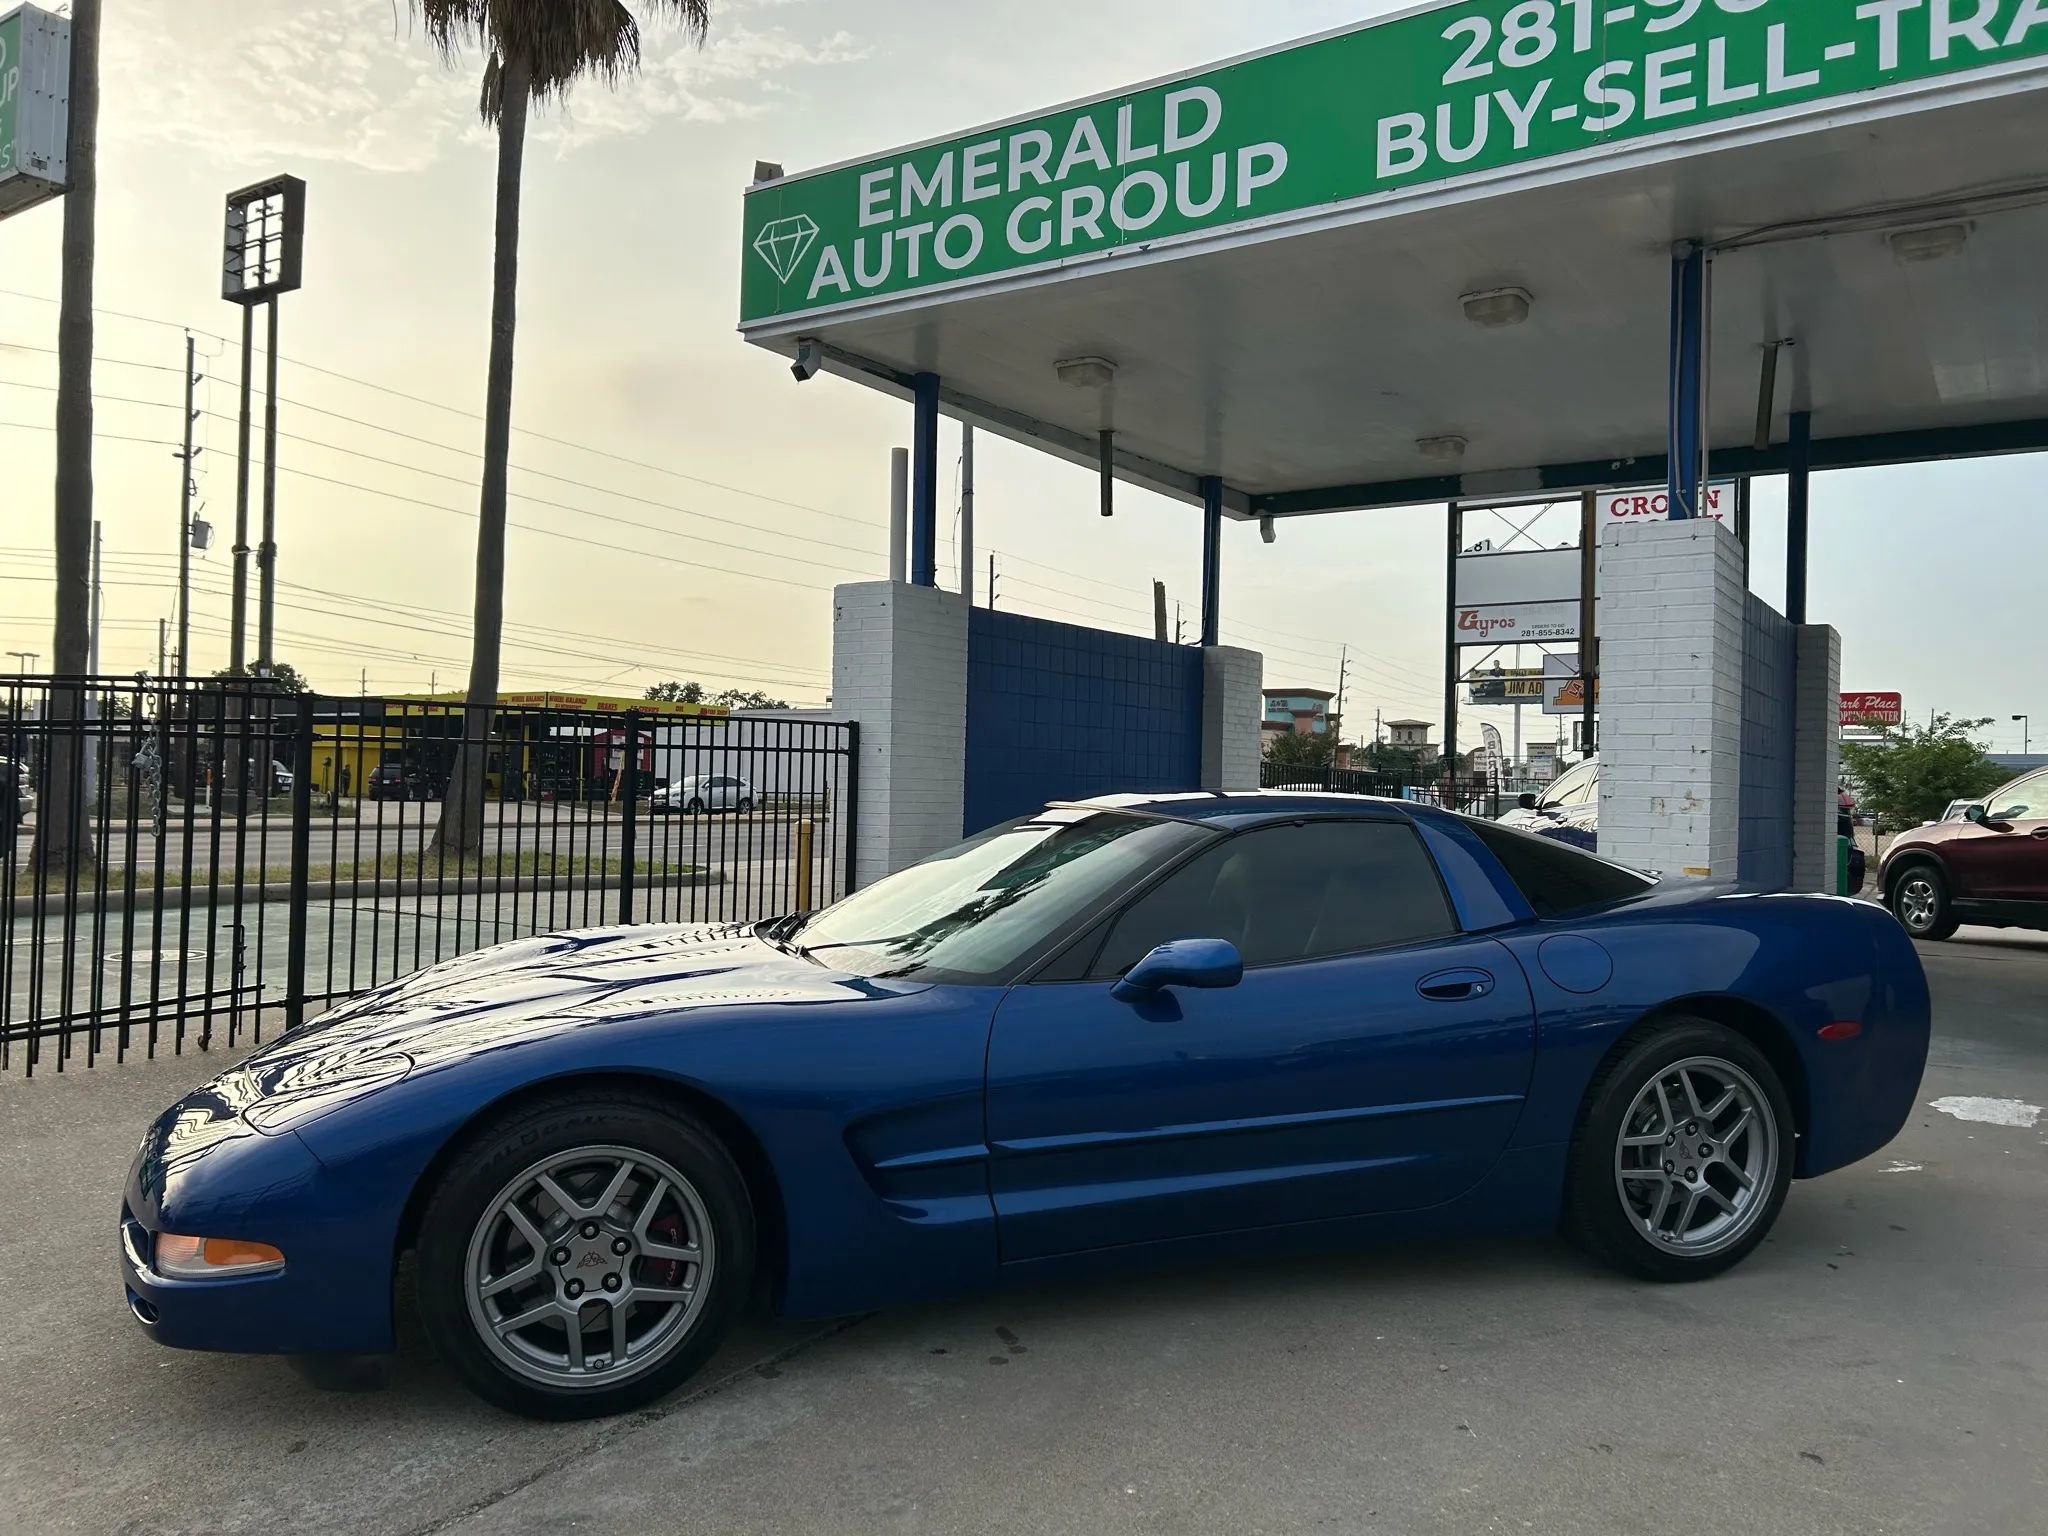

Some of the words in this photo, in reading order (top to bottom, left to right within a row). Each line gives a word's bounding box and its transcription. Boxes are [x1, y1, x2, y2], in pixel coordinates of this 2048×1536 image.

[858, 85, 1222, 229] EMERALD
[806, 213, 983, 300] AUTO
[1006, 142, 1288, 254] GROUP
[1610, 490, 1720, 517] CRON
[1458, 610, 1516, 638] Gyros
[1521, 628, 1575, 637] 281-855-8342
[1507, 682, 1525, 694] JIM
[1840, 696, 1860, 709] ark
[1864, 695, 1897, 709] Place
